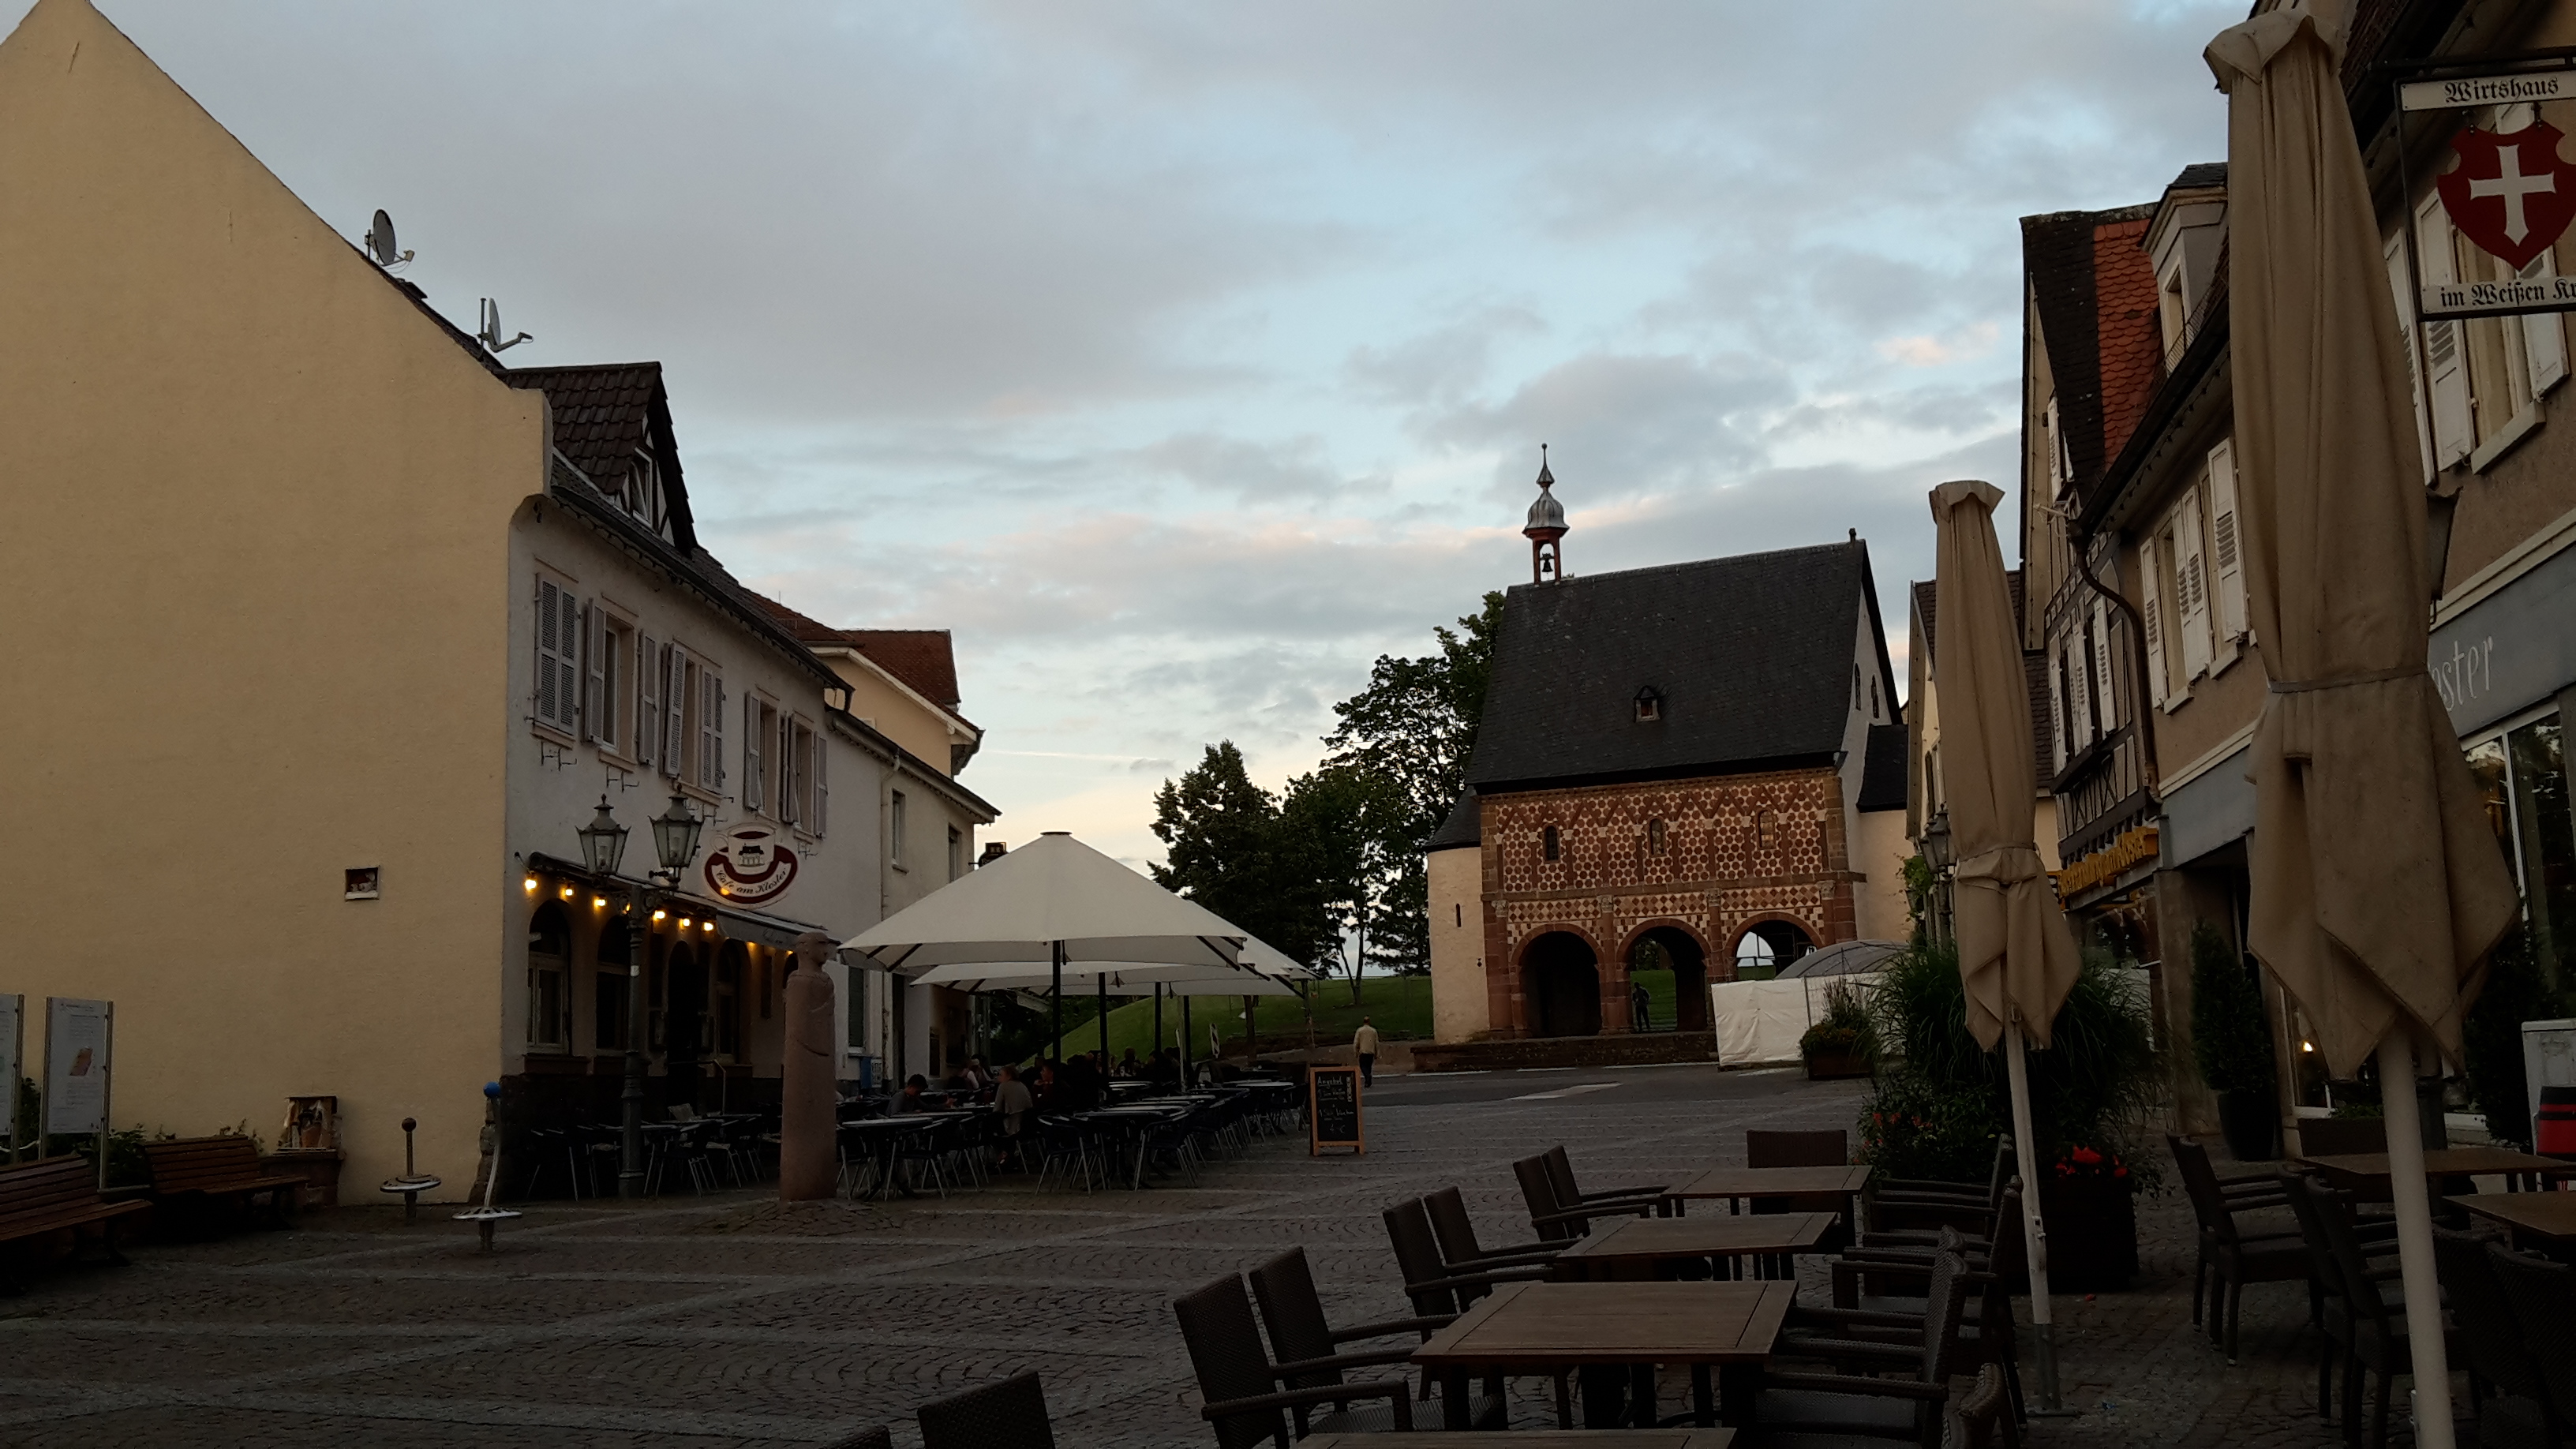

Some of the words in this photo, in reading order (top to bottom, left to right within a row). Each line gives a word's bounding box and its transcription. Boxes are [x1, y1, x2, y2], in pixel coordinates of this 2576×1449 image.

[2444, 77, 2559, 103] Wirtshaus
[2441, 286, 2464, 307] im
[2471, 282, 2545, 307] Weißen
